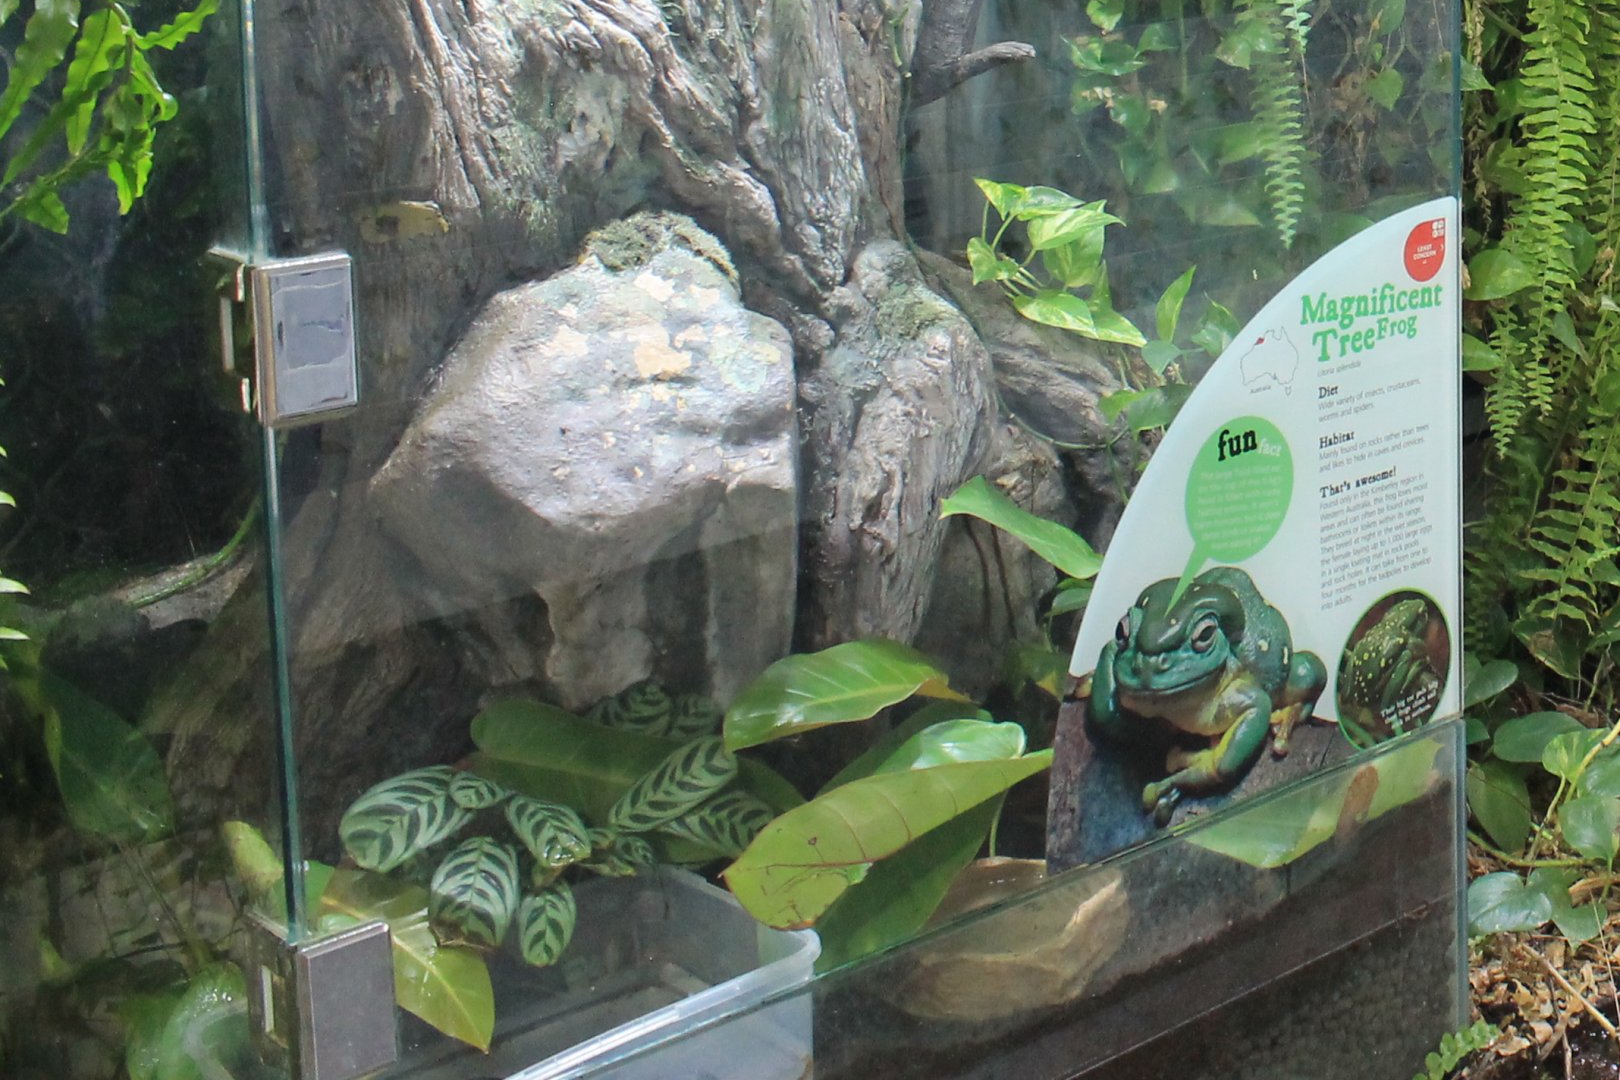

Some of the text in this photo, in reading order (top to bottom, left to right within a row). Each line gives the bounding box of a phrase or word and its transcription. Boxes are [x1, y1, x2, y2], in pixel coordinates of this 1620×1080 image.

[1300, 283, 1443, 330] Magnificent
[1312, 316, 1417, 362] Tree Frog
[1319, 386, 1338, 399] Diet
[1218, 429, 1282, 462] fun fact
[1319, 431, 1355, 449] Habitat
[1340, 444, 1357, 454] found
[1320, 462, 1331, 473] and
[1320, 466, 1397, 498] That's awesome!
